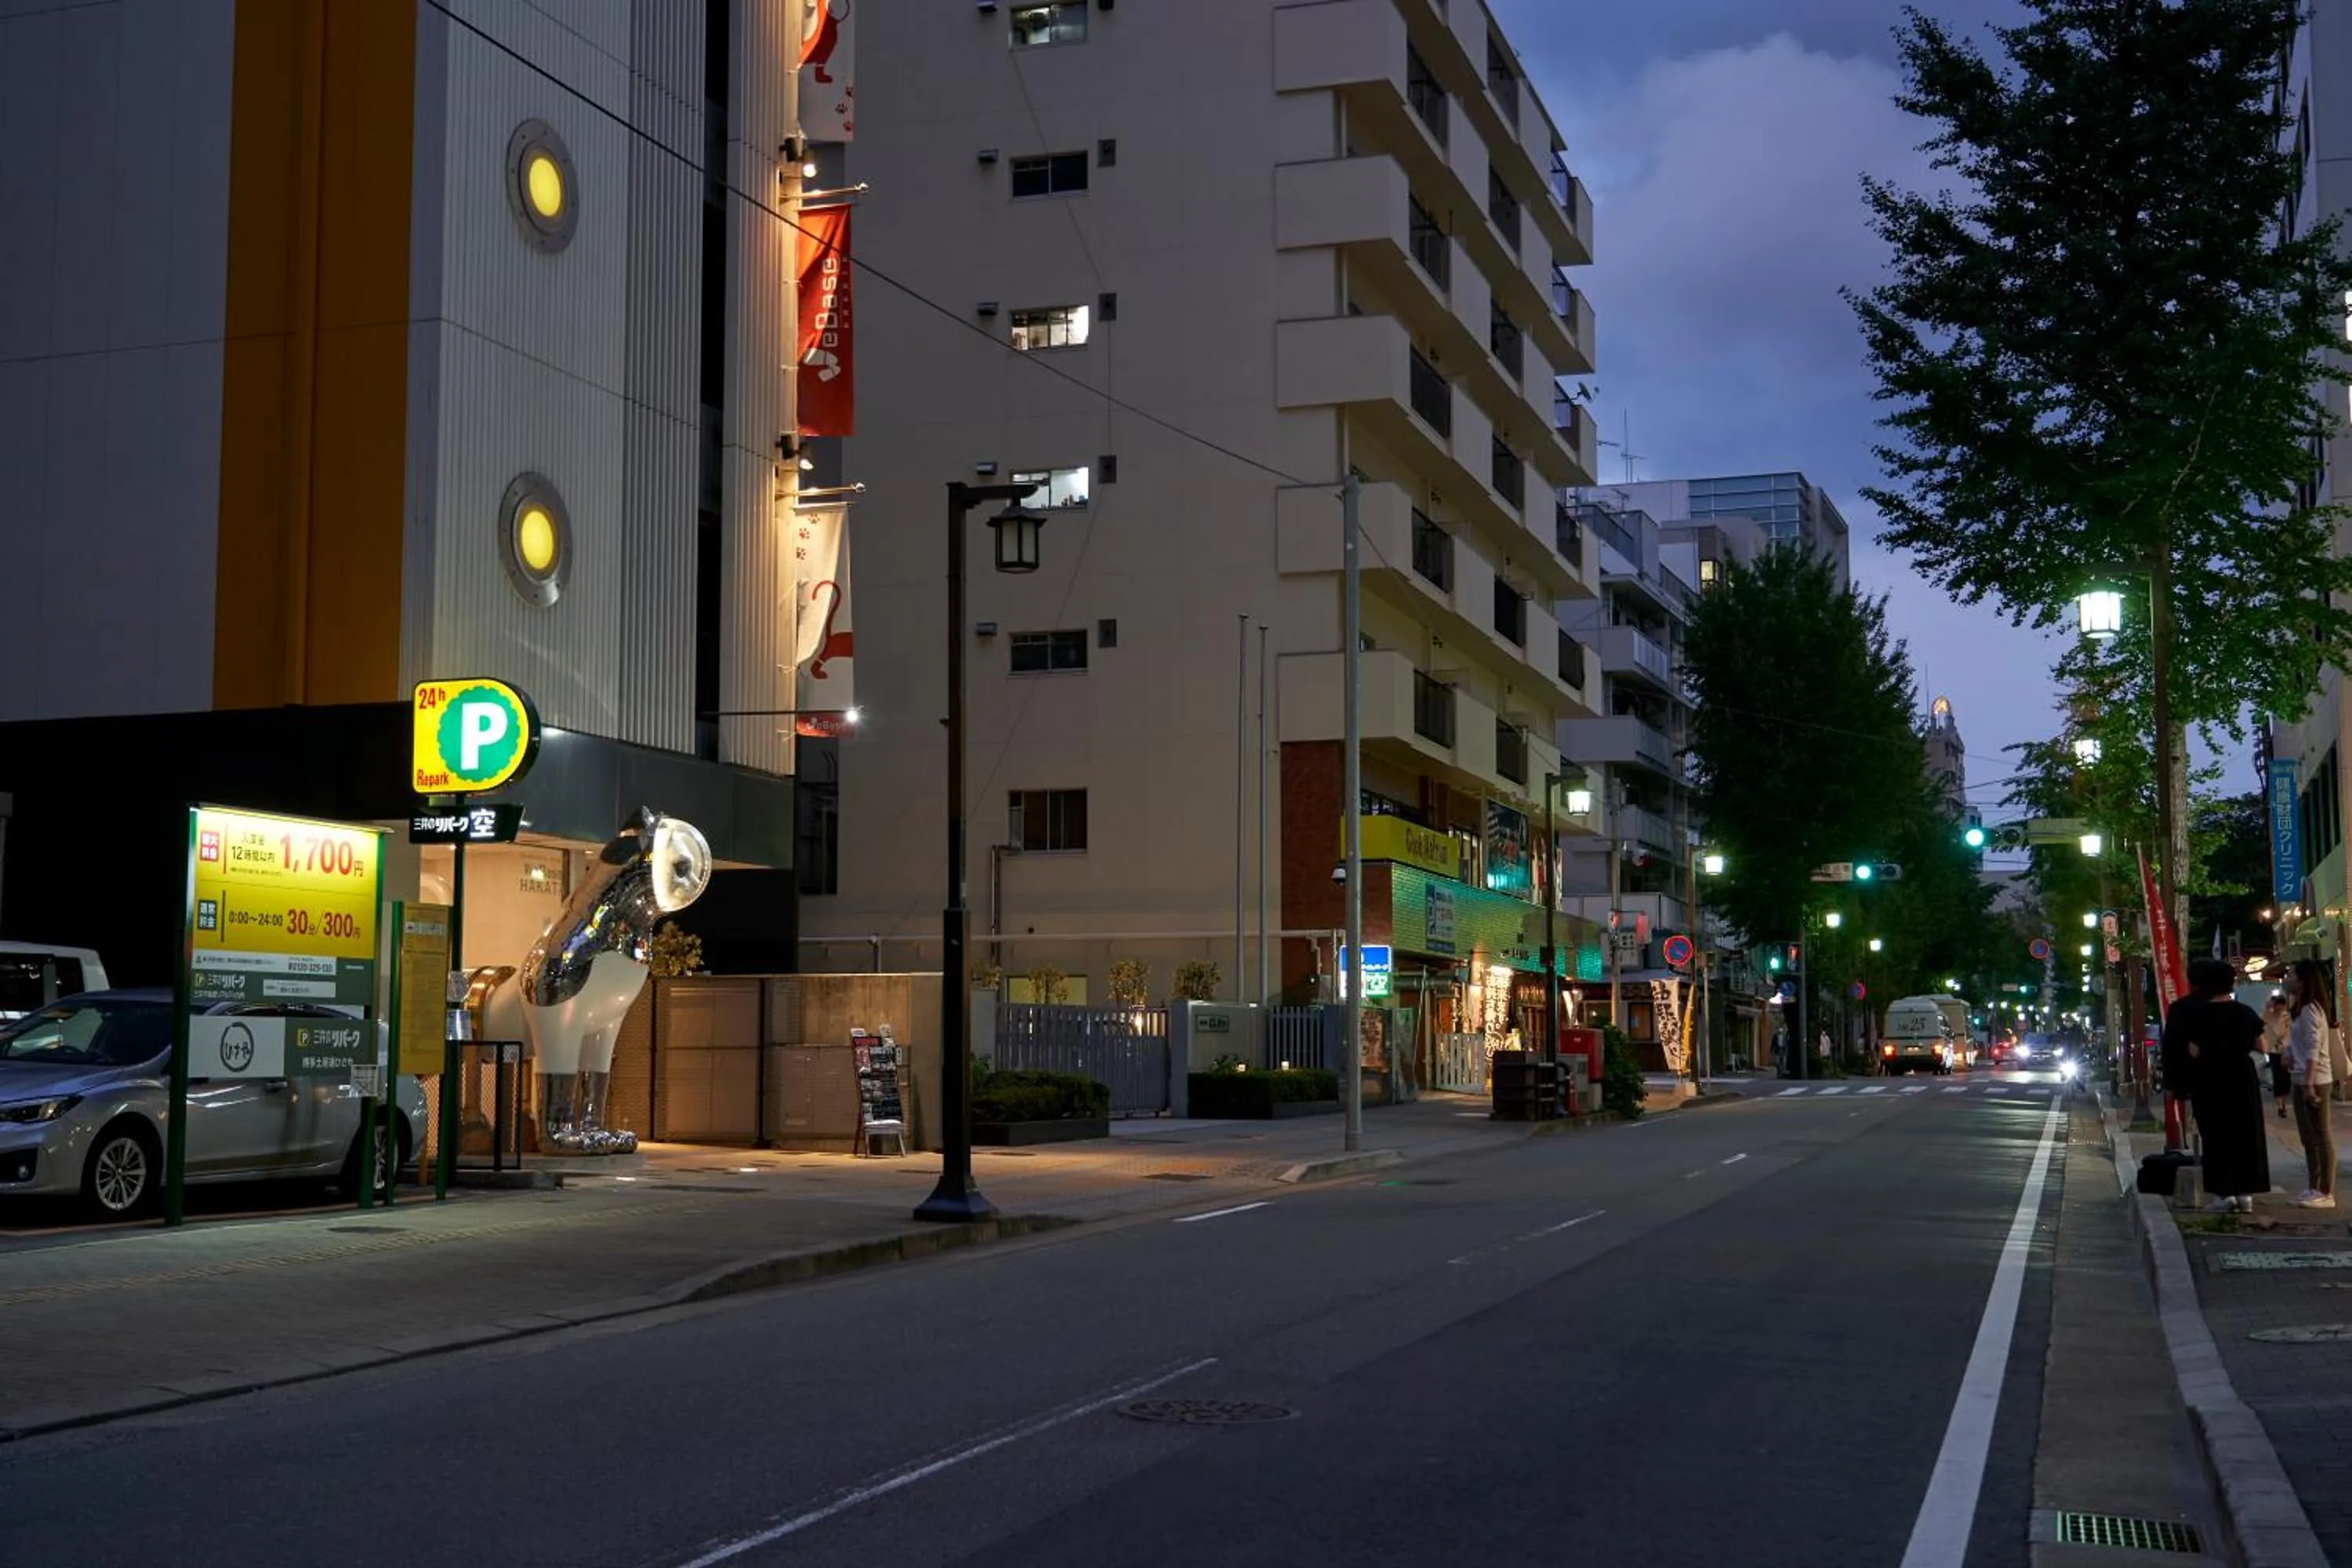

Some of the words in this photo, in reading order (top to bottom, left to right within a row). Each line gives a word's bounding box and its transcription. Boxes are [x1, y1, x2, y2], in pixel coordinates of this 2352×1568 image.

[419, 688, 446, 709] 24h
[461, 702, 508, 770] P
[416, 769, 449, 786] Repark
[413, 816, 469, 833] 三井のリパーク
[470, 808, 496, 838] 空
